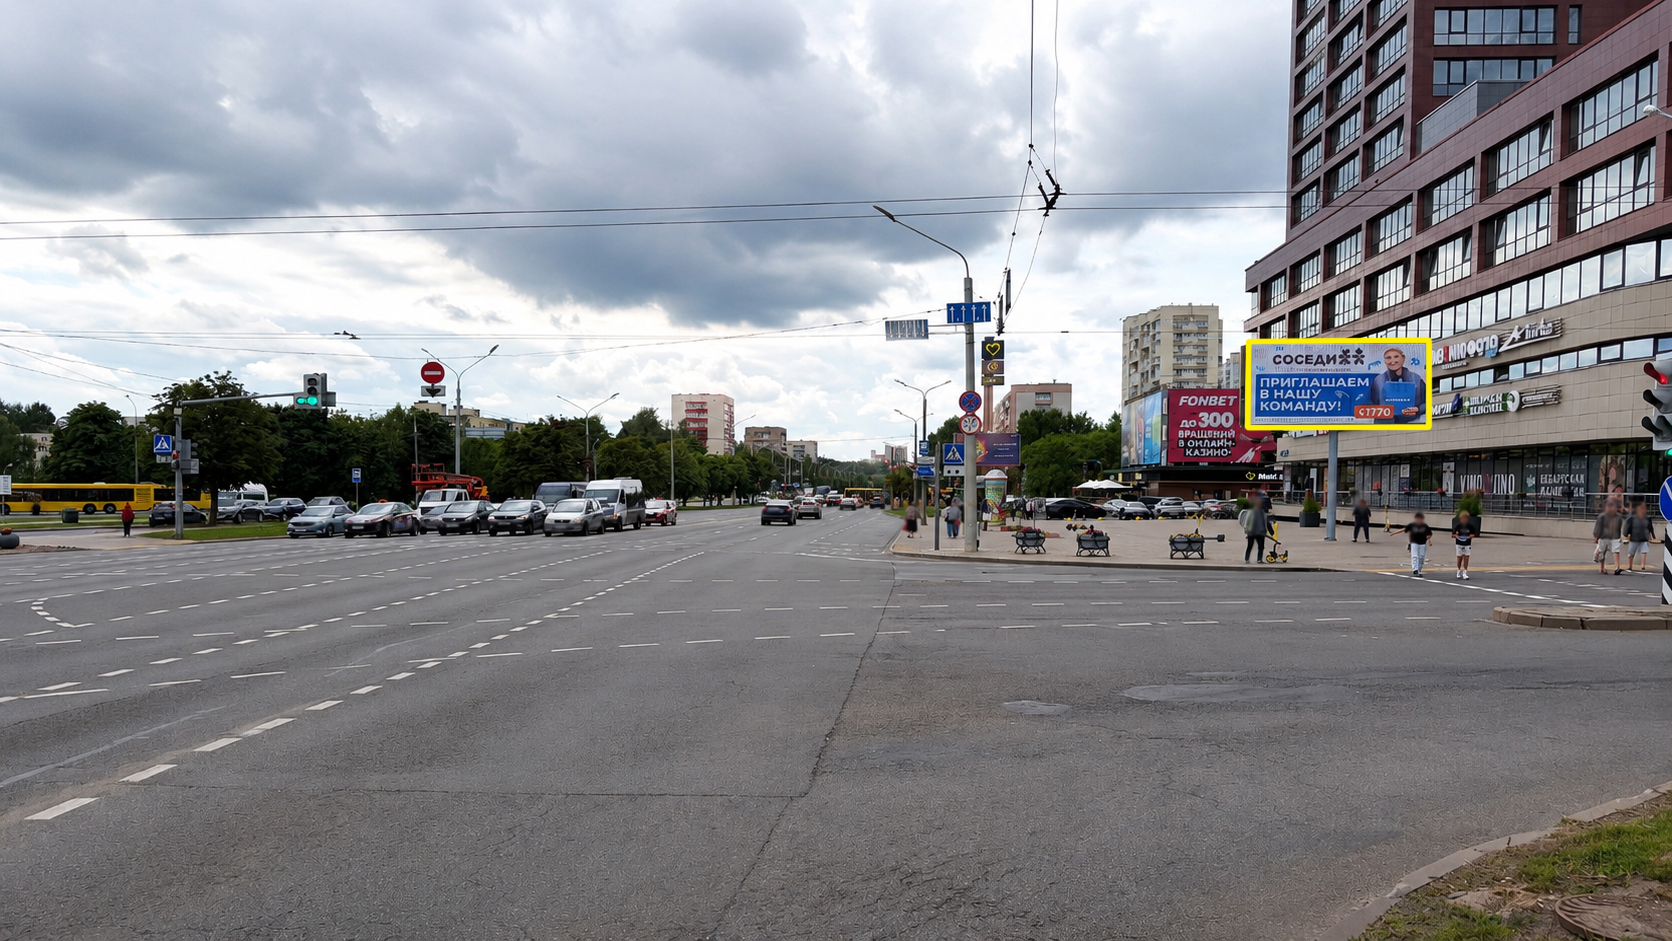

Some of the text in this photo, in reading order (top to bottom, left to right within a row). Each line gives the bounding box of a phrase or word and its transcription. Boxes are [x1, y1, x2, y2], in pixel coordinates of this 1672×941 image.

[1272, 354, 1336, 366] СОСЕДИ
[1260, 377, 1369, 388] ПРИГЛАШАЕМ
[1260, 389, 1322, 399] В НАШУ
[1178, 395, 1237, 406] FONBET
[1260, 401, 1341, 413] КОМАНДУ!
[1366, 407, 1391, 417] 1770
[1179, 411, 1234, 428] до 300
[1178, 439, 1185, 447] В
